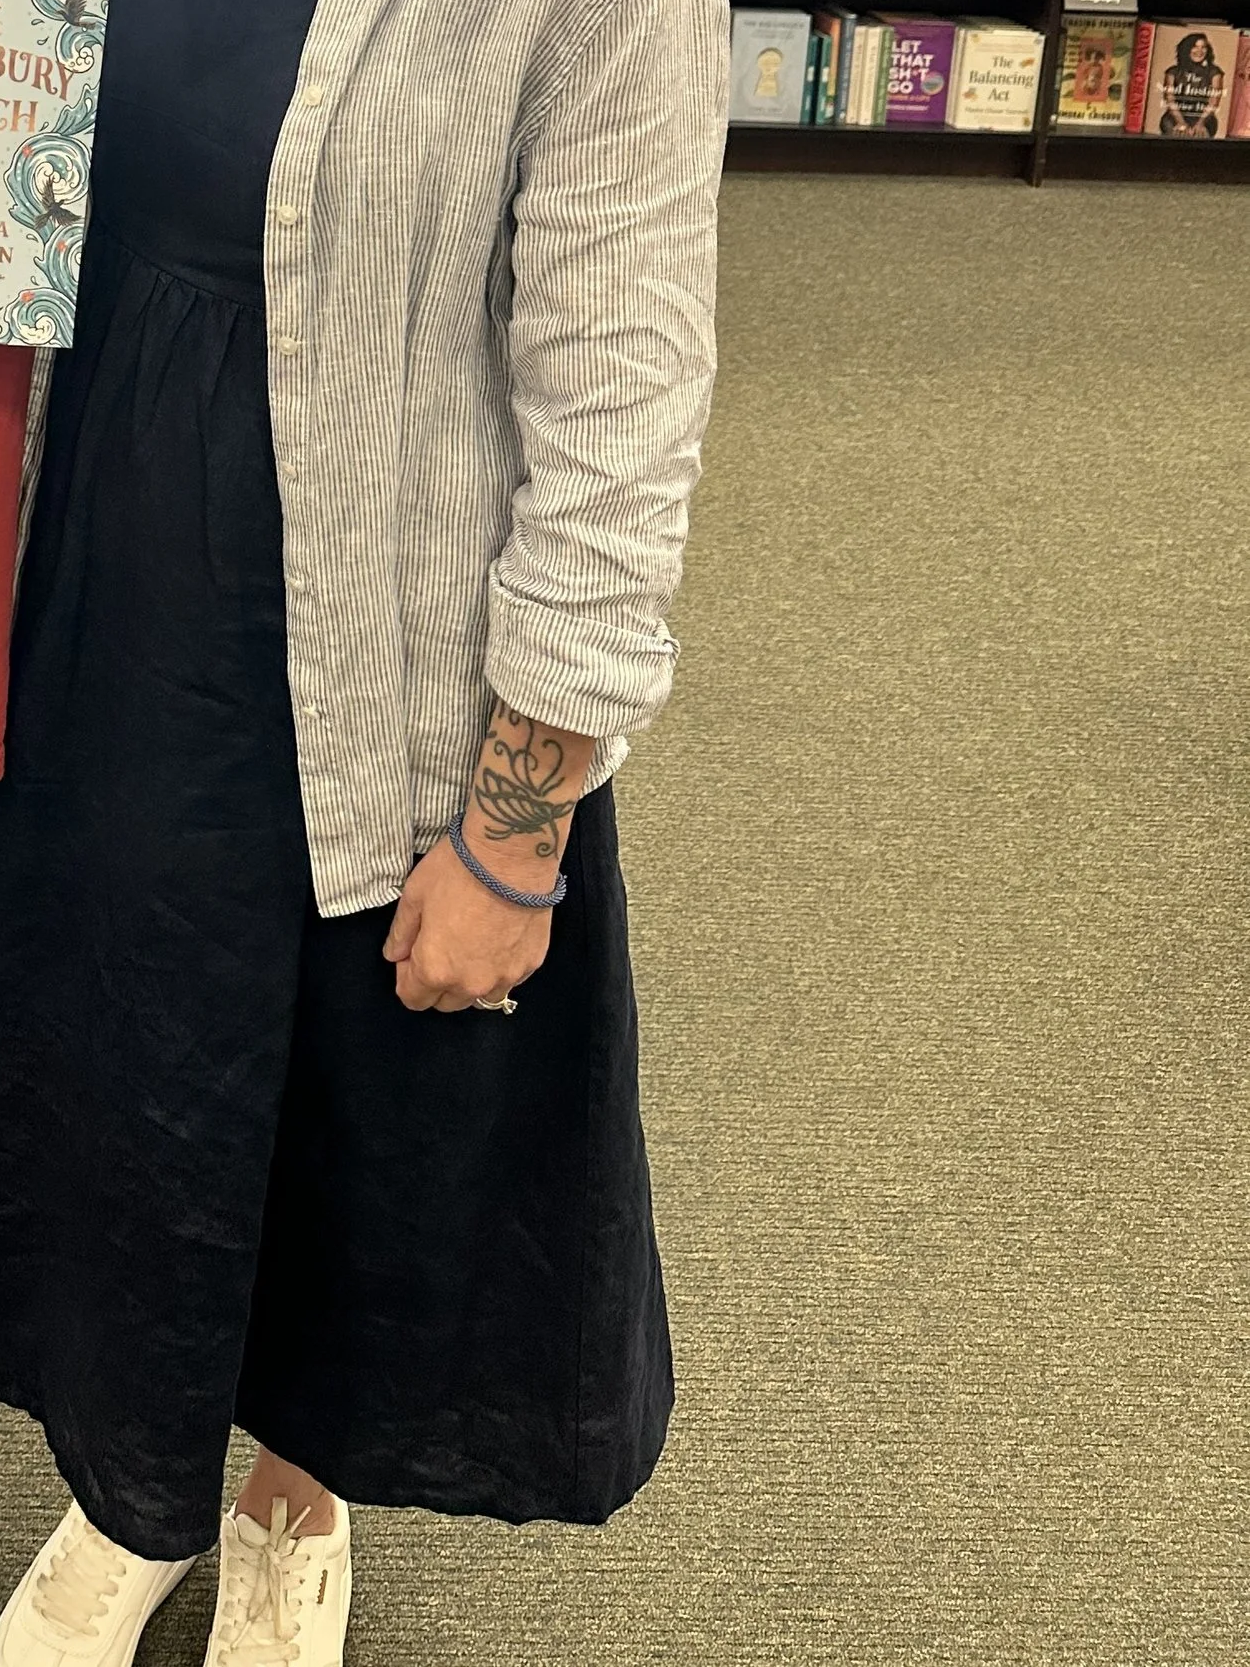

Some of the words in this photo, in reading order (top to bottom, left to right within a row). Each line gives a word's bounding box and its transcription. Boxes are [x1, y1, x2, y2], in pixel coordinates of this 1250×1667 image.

[891, 40, 922, 53] LET
[891, 53, 934, 67] THAT
[993, 55, 1014, 68] The
[969, 70, 1034, 88] Balancing
[887, 80, 914, 94] GO
[988, 87, 1010, 101] Act
